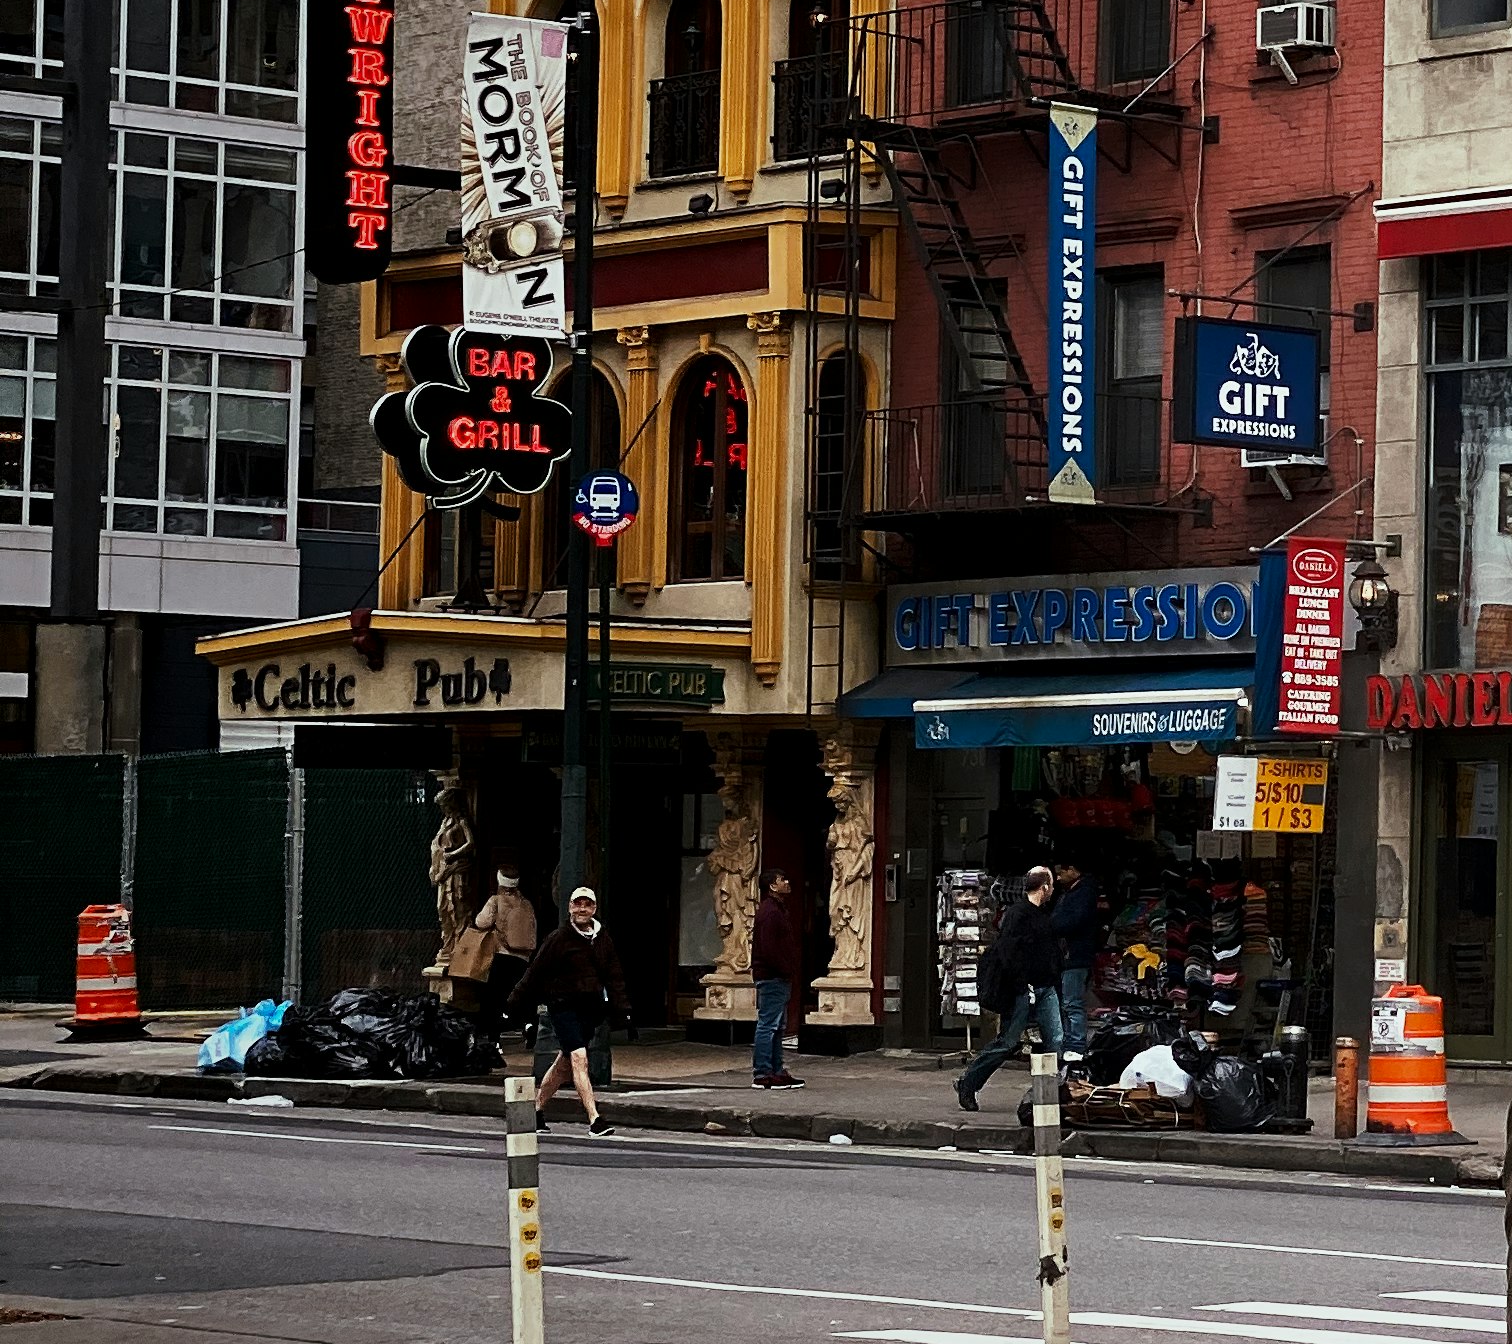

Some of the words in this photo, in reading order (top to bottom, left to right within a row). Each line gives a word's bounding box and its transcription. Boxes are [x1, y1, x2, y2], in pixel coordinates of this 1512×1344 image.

[507, 33, 529, 81] THE
[516, 91, 541, 164] BOOK
[530, 169, 550, 203] OF
[1062, 156, 1084, 230] GIFT
[1062, 239, 1084, 453] EXPRESSIONS
[468, 348, 537, 380] BAR
[490, 386, 511, 413] &
[1218, 380, 1290, 419] GIFT
[449, 416, 551, 453] GRILL
[1212, 416, 1297, 440] EXPRESSIONS
[1289, 585, 1339, 598] BREAKFAST
[1299, 598, 1329, 609] LUNCH
[894, 593, 976, 650] GIFT
[254, 663, 356, 711] Celtic
[413, 657, 488, 706] Pub
[598, 671, 662, 694] ELTIC
[668, 672, 706, 695] PUB
[1093, 711, 1157, 735] SOUVENIRS
[1169, 708, 1227, 732] LUGGAGE
[1279, 711, 1313, 723] ITALIAN
[1315, 713, 1338, 725] FOOD
[1259, 762, 1323, 778] T-SHIRTS
[1255, 781, 1301, 804] 5/$10
[1219, 816, 1230, 828] $1
